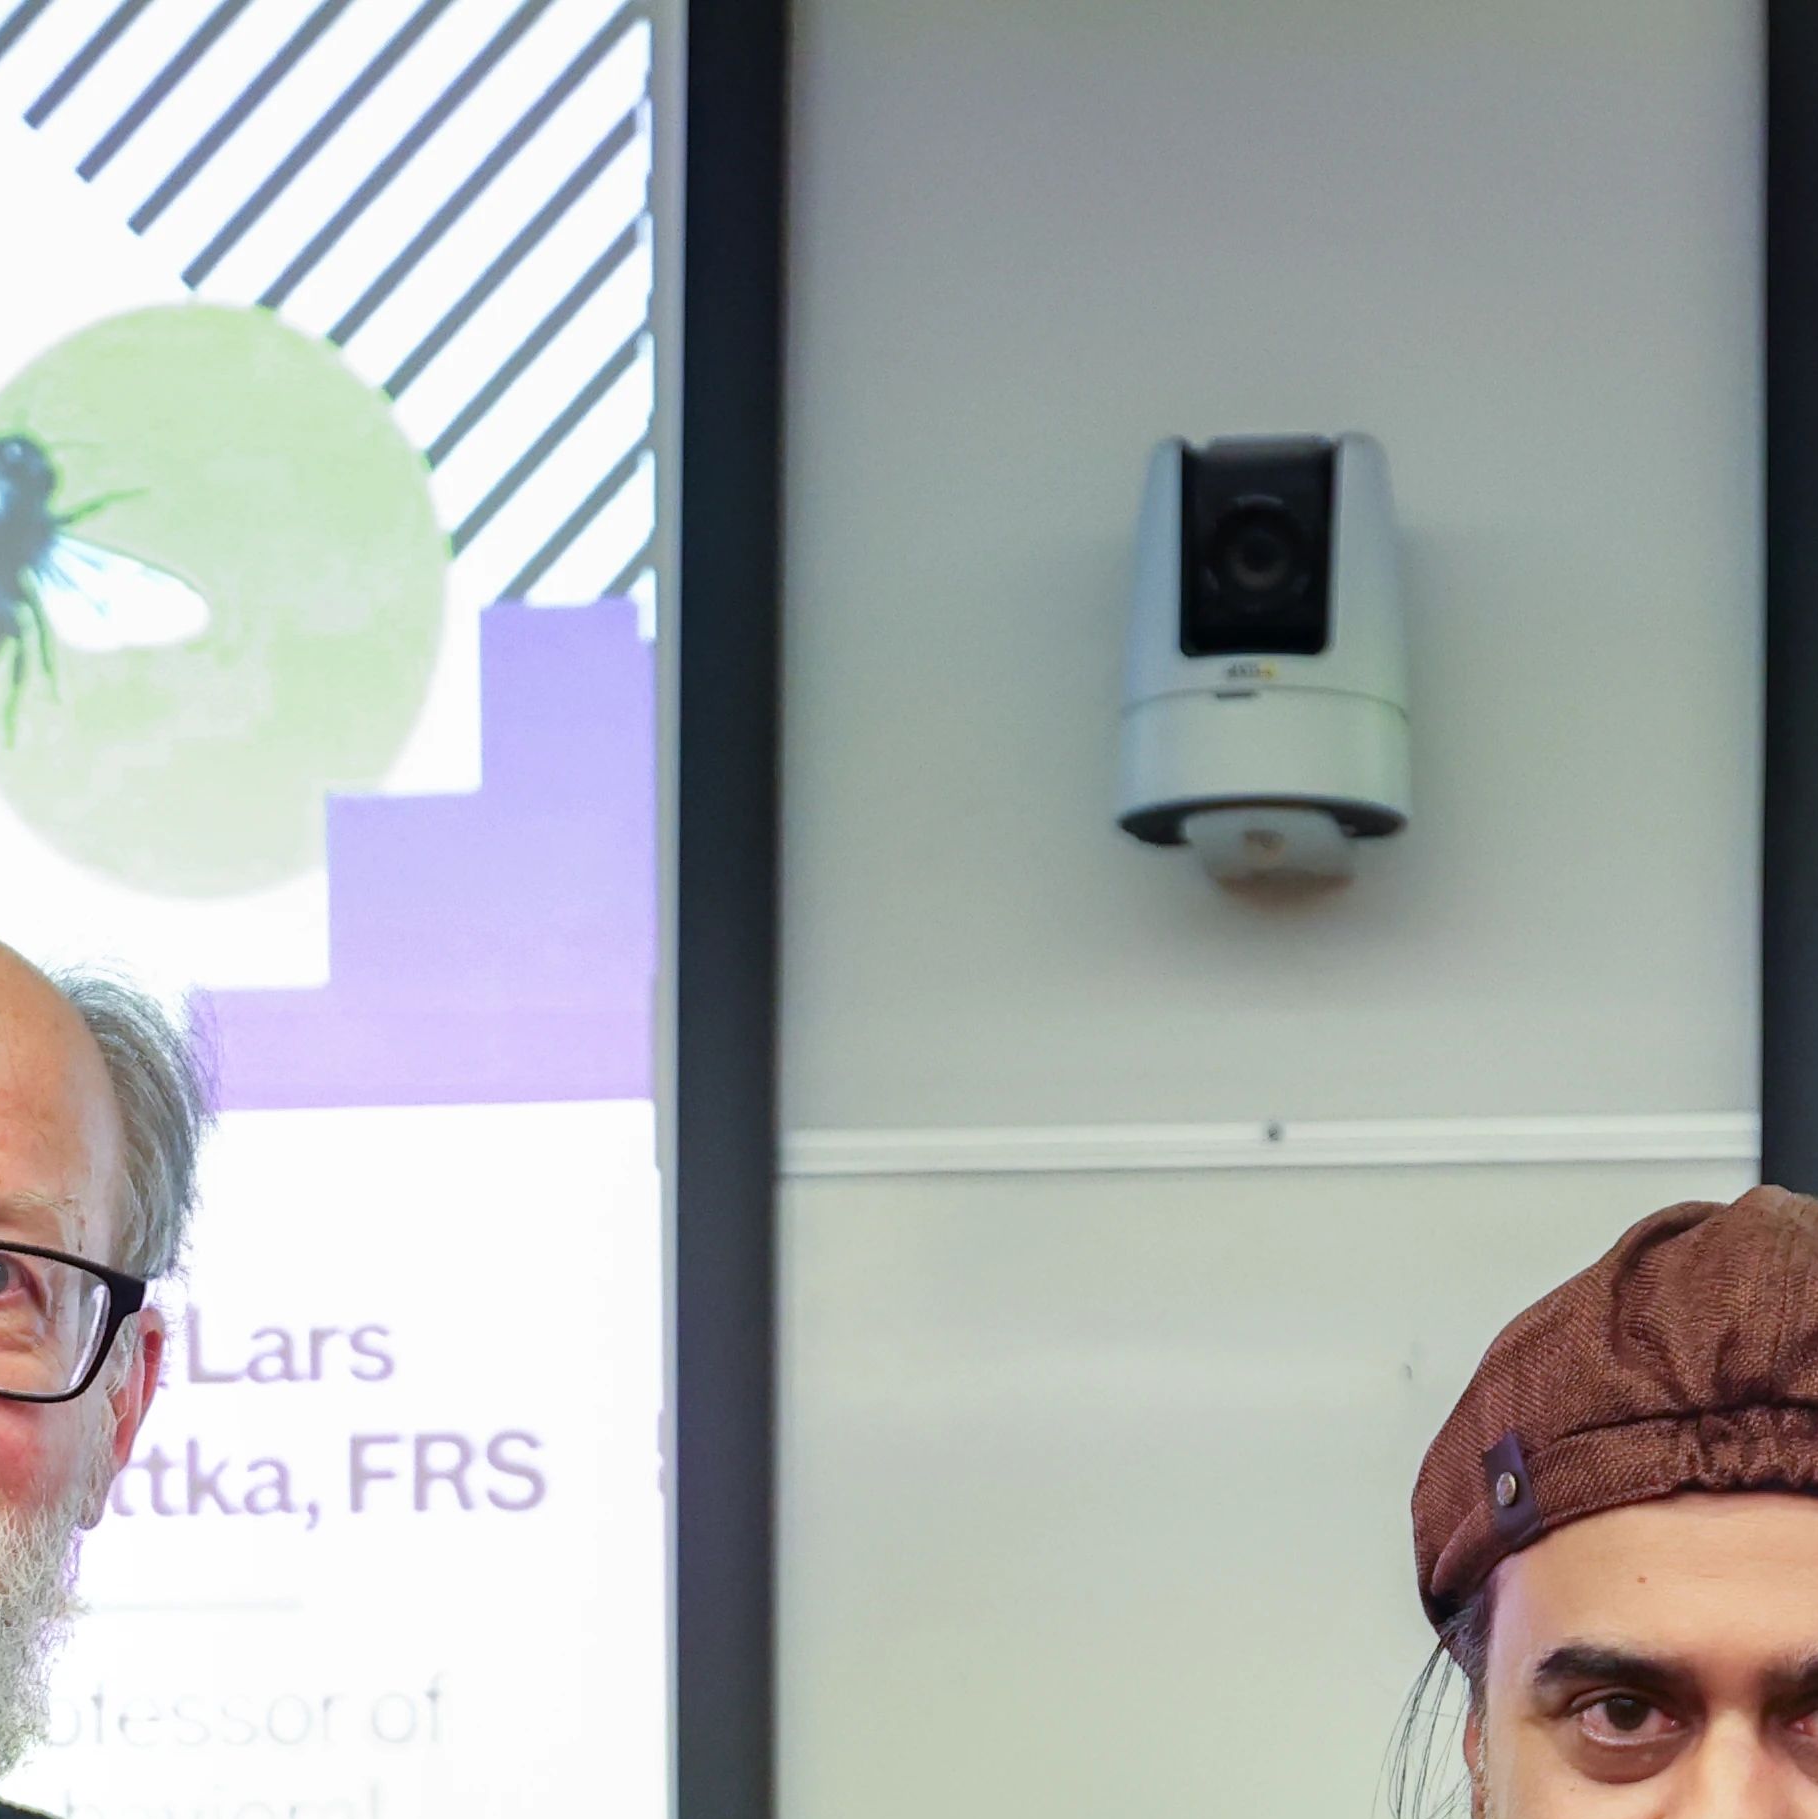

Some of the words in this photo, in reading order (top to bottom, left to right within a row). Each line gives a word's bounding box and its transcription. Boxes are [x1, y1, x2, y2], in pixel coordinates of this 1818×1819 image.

[185, 1302, 395, 1384] Lars
[348, 1429, 548, 1514] FRS
[369, 1669, 450, 1746] of
